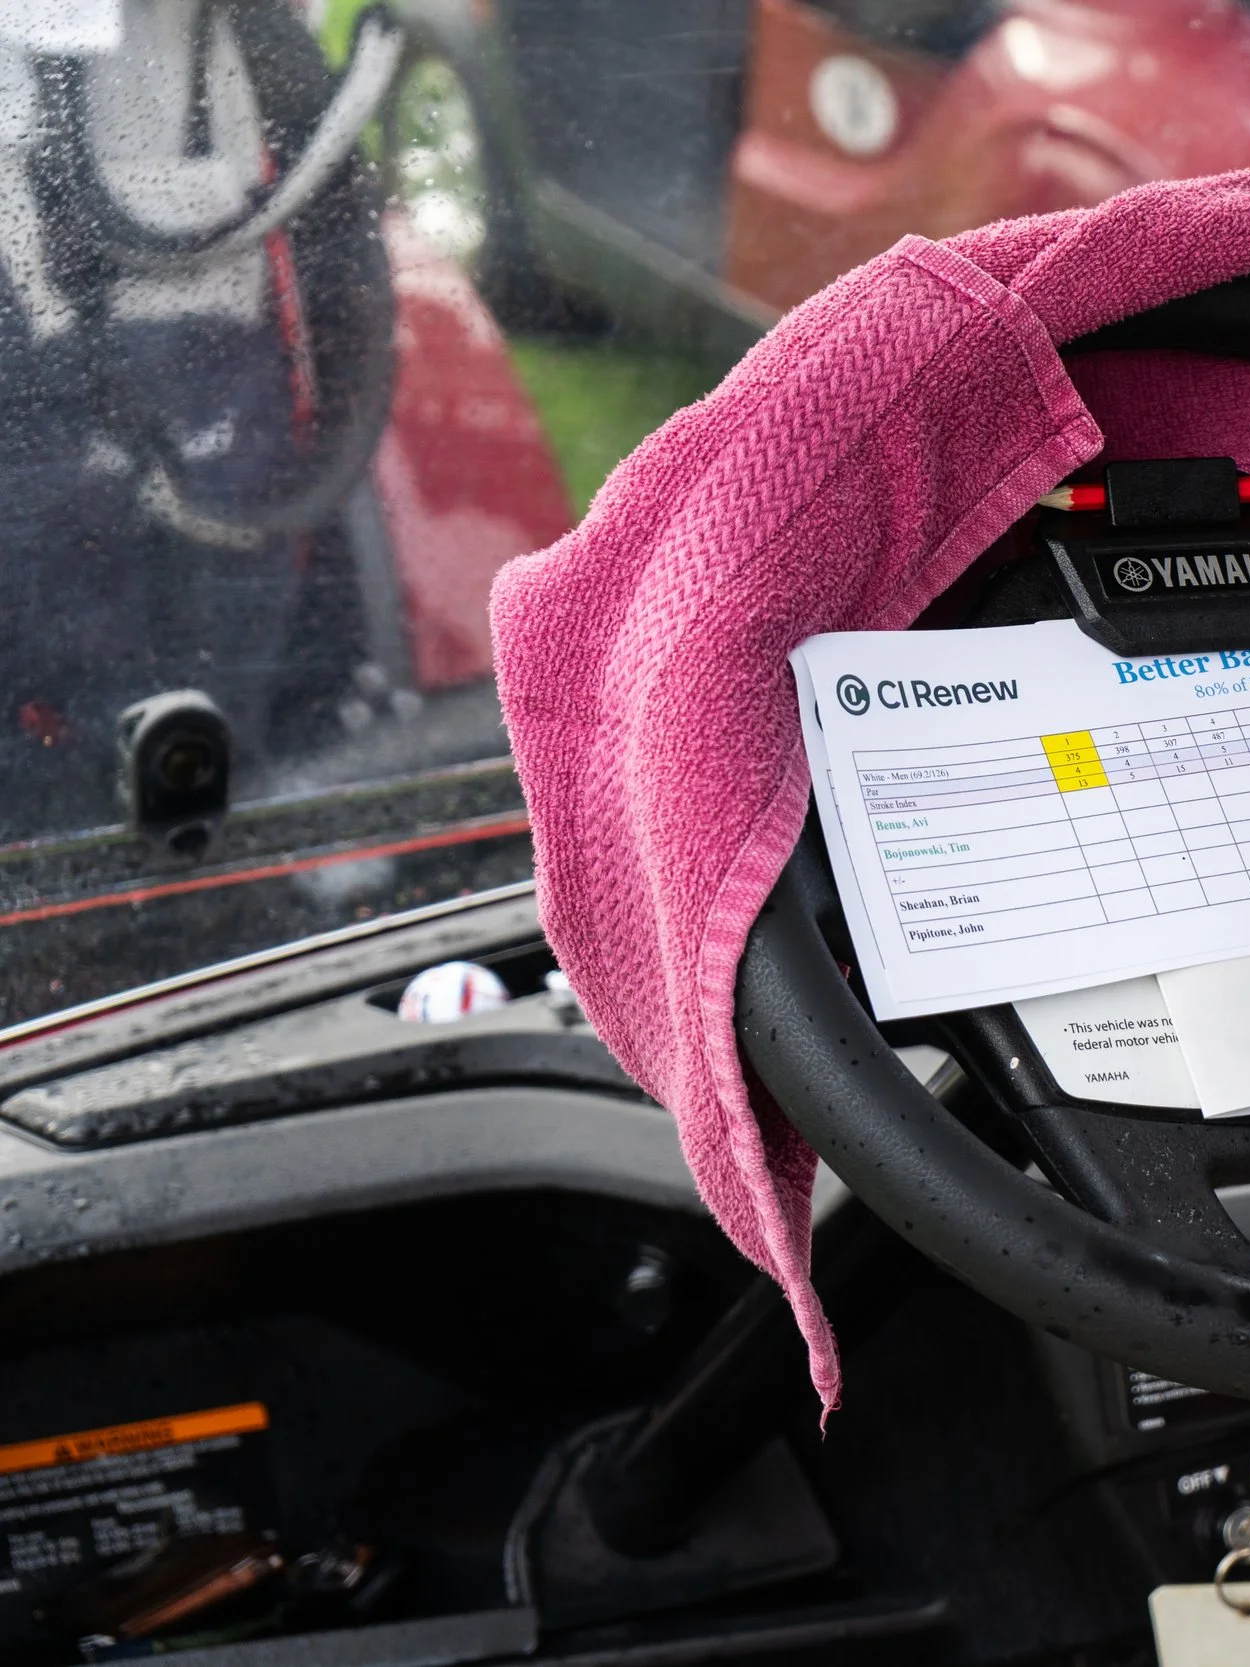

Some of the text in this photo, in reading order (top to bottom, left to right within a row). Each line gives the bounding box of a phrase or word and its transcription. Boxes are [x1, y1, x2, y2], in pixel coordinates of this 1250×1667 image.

[1112, 654, 1211, 684] Better
[910, 679, 1018, 708] Renew
[1194, 681, 1229, 699] 80%
[1232, 677, 1249, 692] of
[863, 773, 885, 782] White
[891, 771, 908, 780] Men
[910, 769, 949, 781] (69.2/126)
[1065, 753, 1081, 761] 375
[1115, 746, 1130, 754] 398
[1164, 739, 1177, 747] 307
[1212, 732, 1225, 740] 487
[866, 788, 879, 797] Par
[869, 801, 894, 810] Stroke
[896, 800, 918, 808] Index
[1079, 779, 1088, 787] 13
[1130, 772, 1135, 780] 5
[1176, 765, 1186, 773] 15
[1224, 758, 1234, 766] 11
[876, 819, 910, 831] Benus,
[912, 816, 929, 828] Avi
[884, 844, 947, 861] Bojonowski,
[948, 842, 970, 852] Tim
[900, 899, 948, 912] Sheahan,
[949, 894, 980, 905] Brian
[909, 927, 957, 942] Pipitone,
[958, 924, 984, 935] John
[1069, 1023, 1093, 1034] This
[1094, 1019, 1134, 1032] vehicle
[1136, 1019, 1159, 1028] was
[1072, 1032, 1179, 1051] federal motor vehi
[1085, 1071, 1130, 1083] YAMAHA
[1177, 1469, 1213, 1495] OFF
